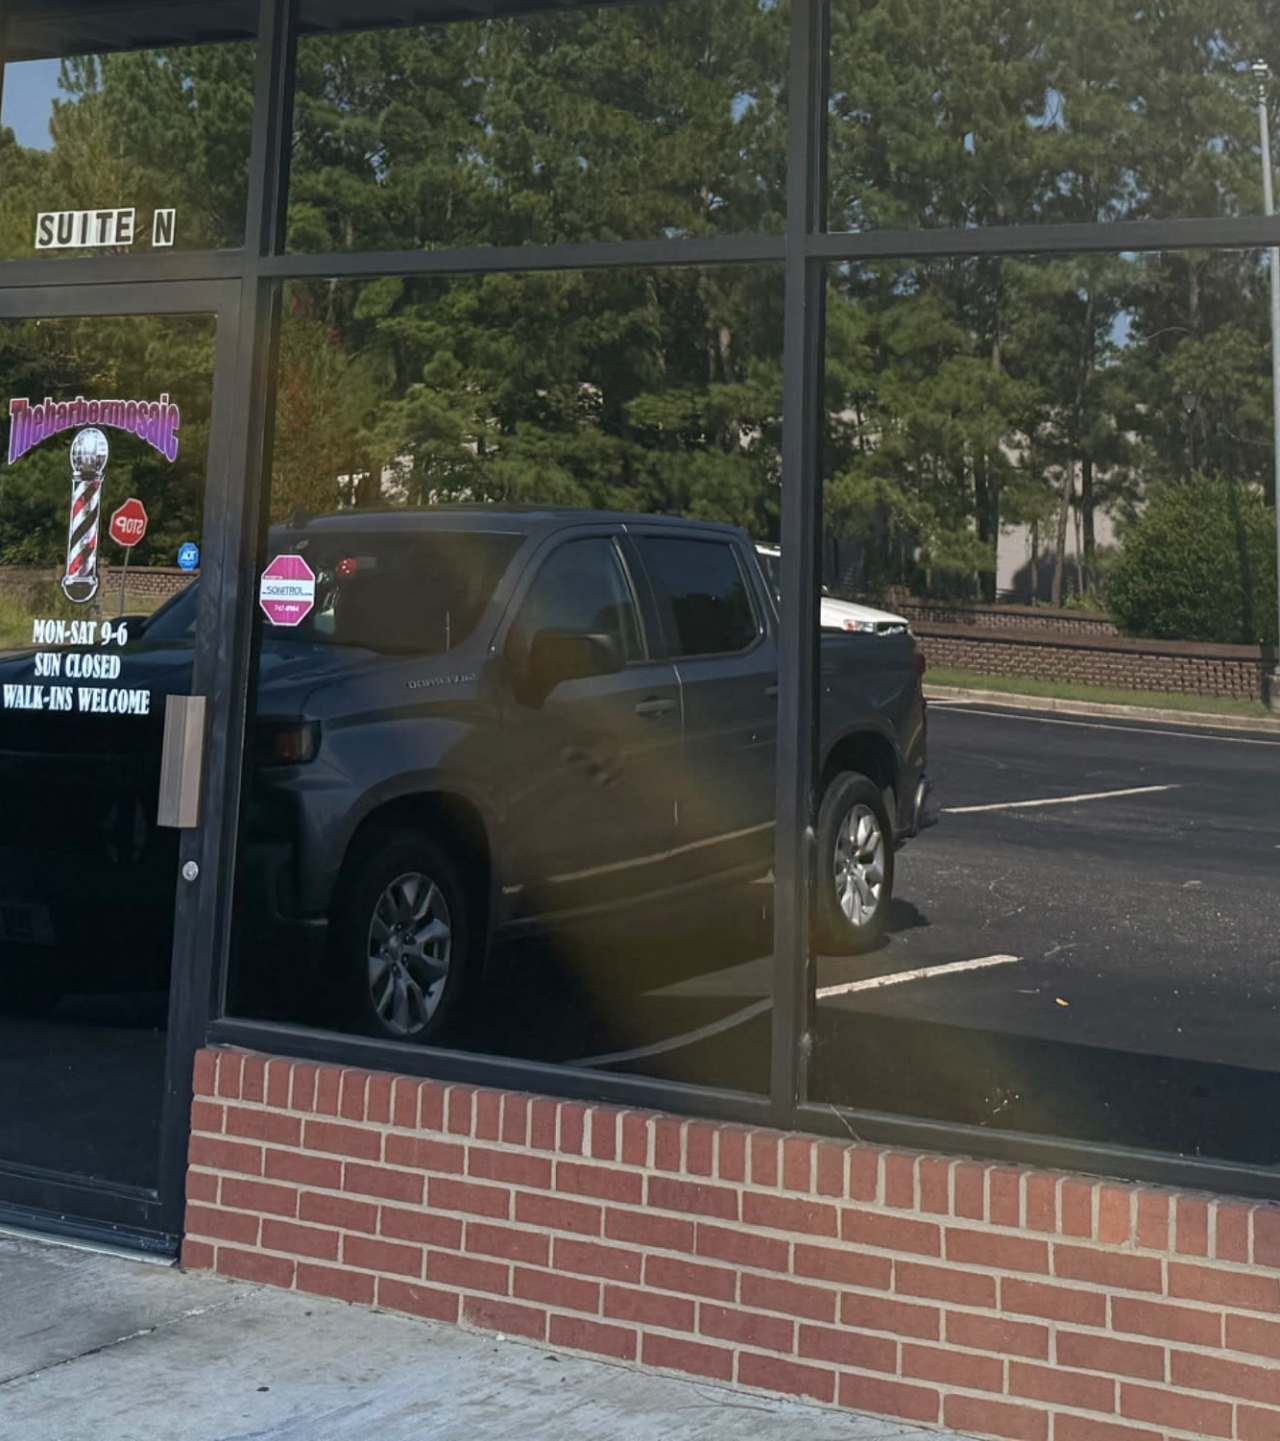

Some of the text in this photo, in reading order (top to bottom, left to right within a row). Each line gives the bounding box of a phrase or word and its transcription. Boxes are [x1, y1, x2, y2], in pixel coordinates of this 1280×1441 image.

[38, 210, 173, 246] SUITE N
[32, 619, 128, 646] MON-SAT 9-6
[34, 652, 121, 679] SUN CLOSED
[3, 683, 150, 715] WALK-INS WELCOME
